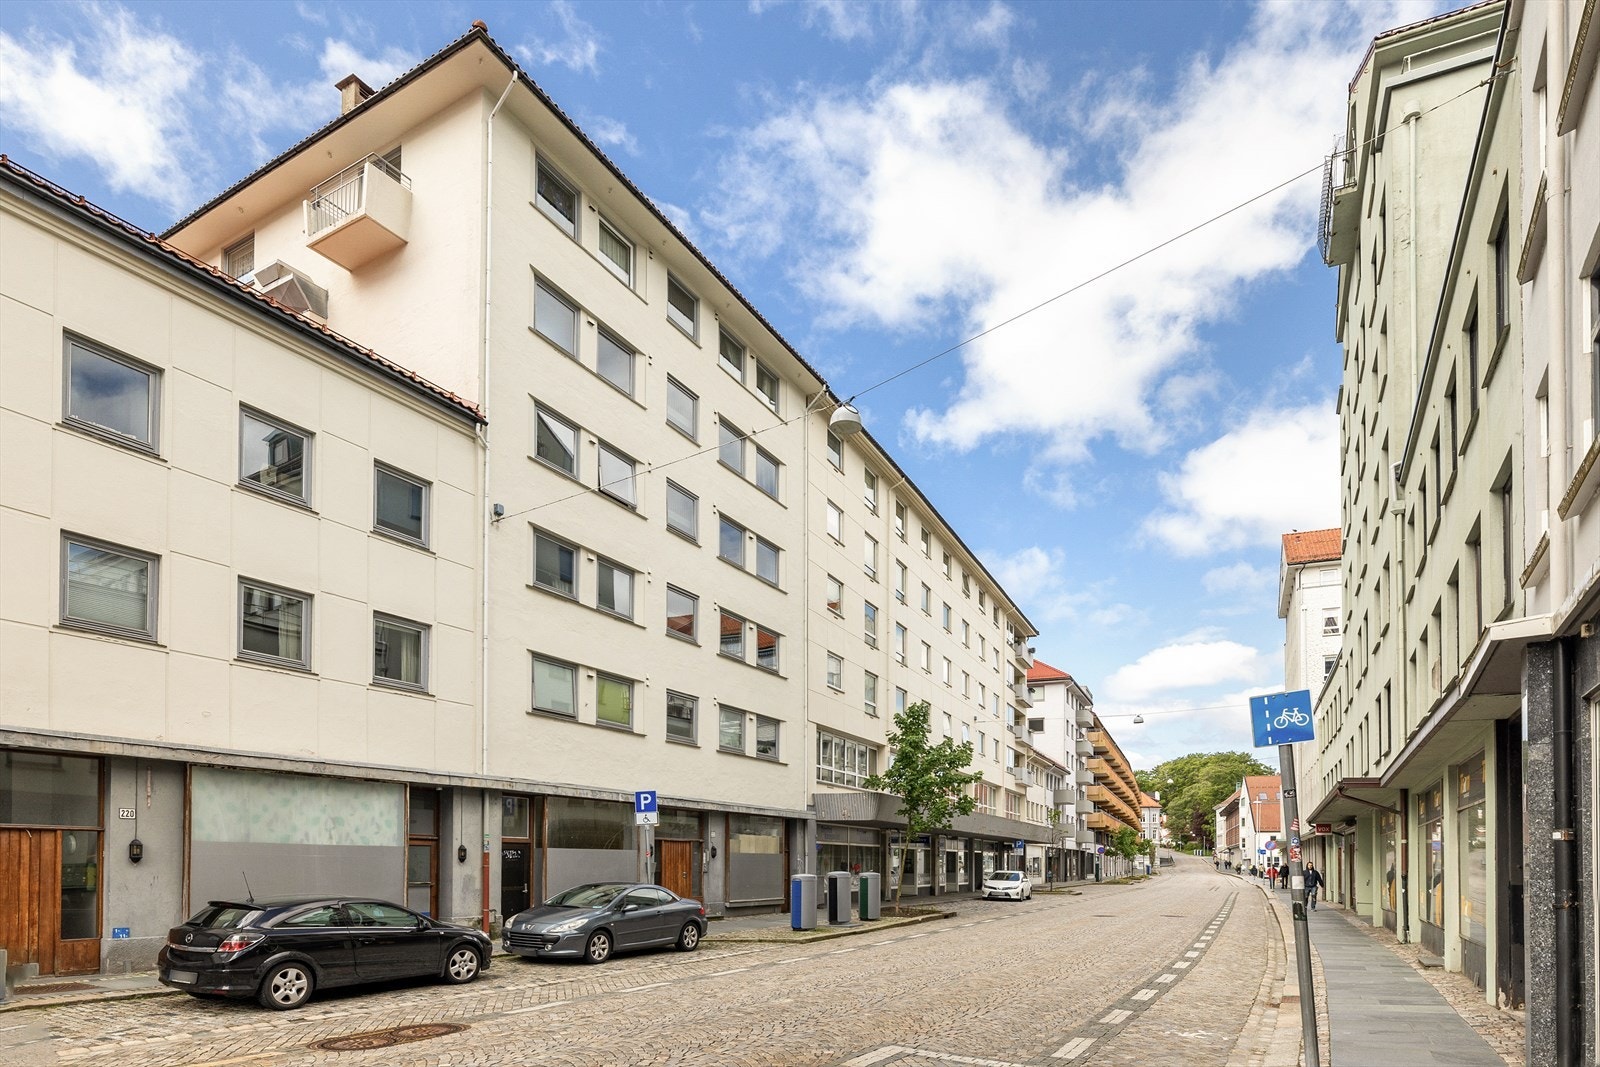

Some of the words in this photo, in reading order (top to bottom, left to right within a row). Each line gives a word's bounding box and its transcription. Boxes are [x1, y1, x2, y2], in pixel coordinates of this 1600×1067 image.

[640, 793, 652, 810] P
[121, 809, 135, 818] 220
[1015, 840, 1022, 848] P
